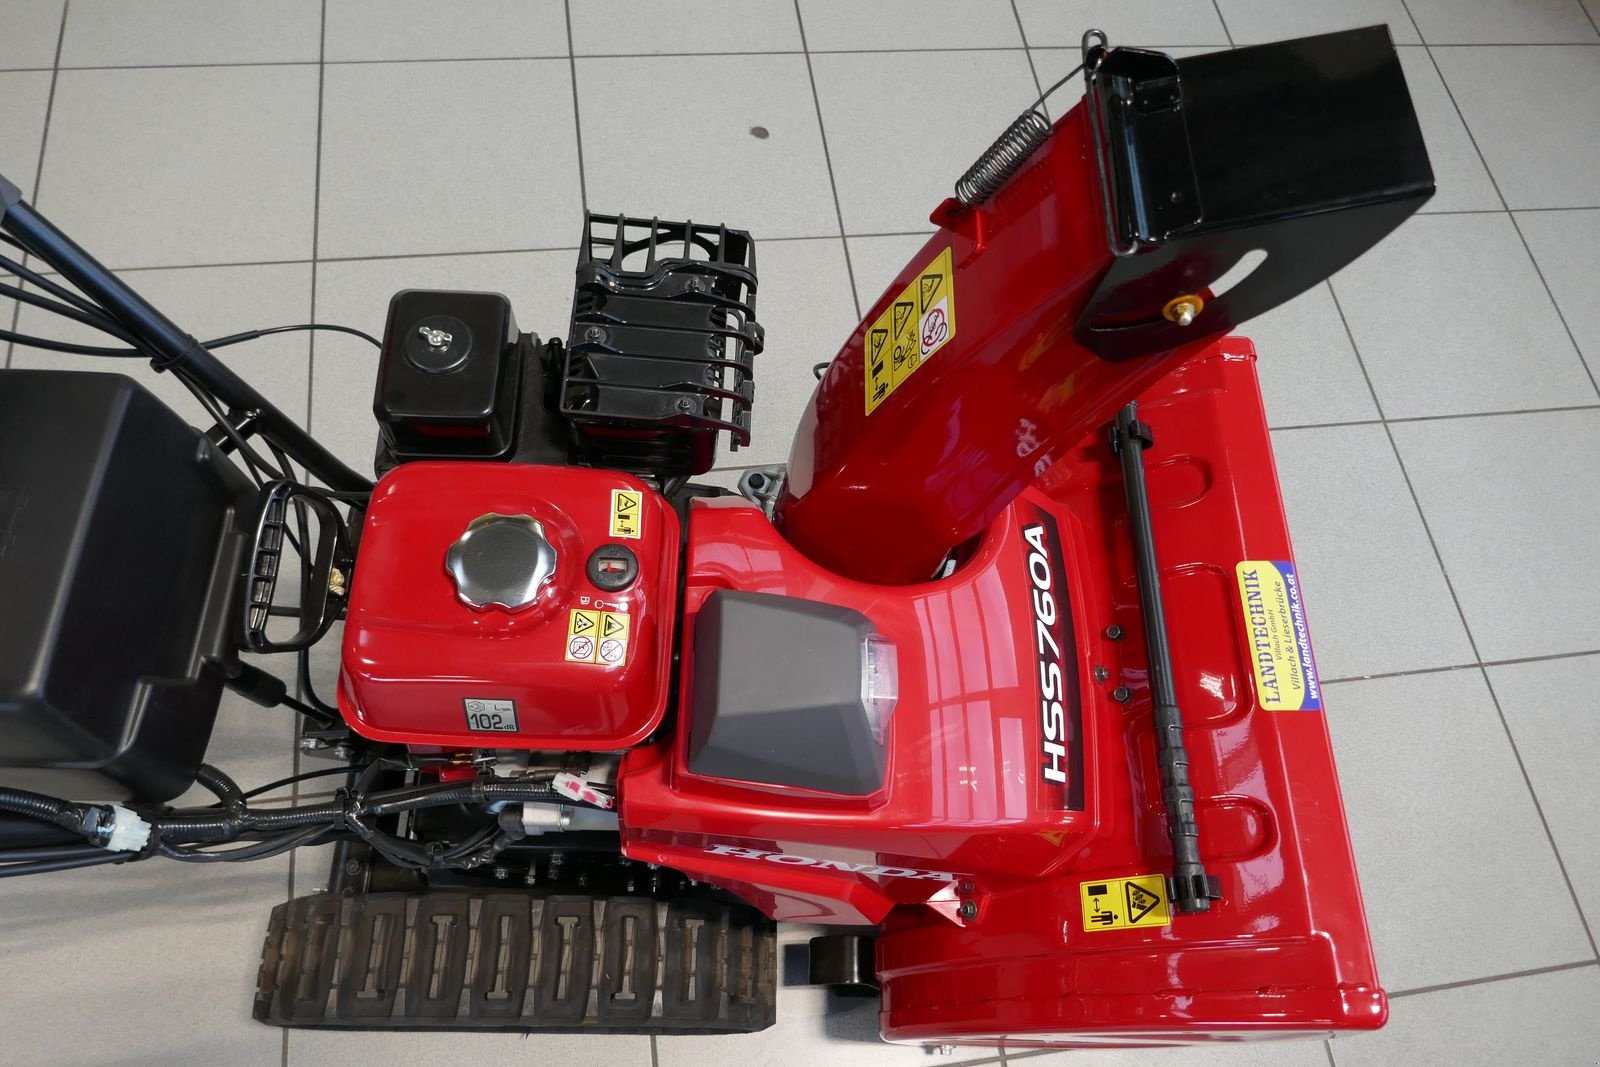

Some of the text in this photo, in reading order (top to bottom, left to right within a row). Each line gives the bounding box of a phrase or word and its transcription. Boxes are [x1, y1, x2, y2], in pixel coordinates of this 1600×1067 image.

[1243, 569, 1281, 703] LANDTECHNIK
[1268, 609, 1282, 660] Villach GmbH
[1274, 581, 1300, 690] Villach & Lieserbrücke
[1285, 573, 1318, 699] www.landtechnik.co.at
[704, 844, 956, 881] HONDA
